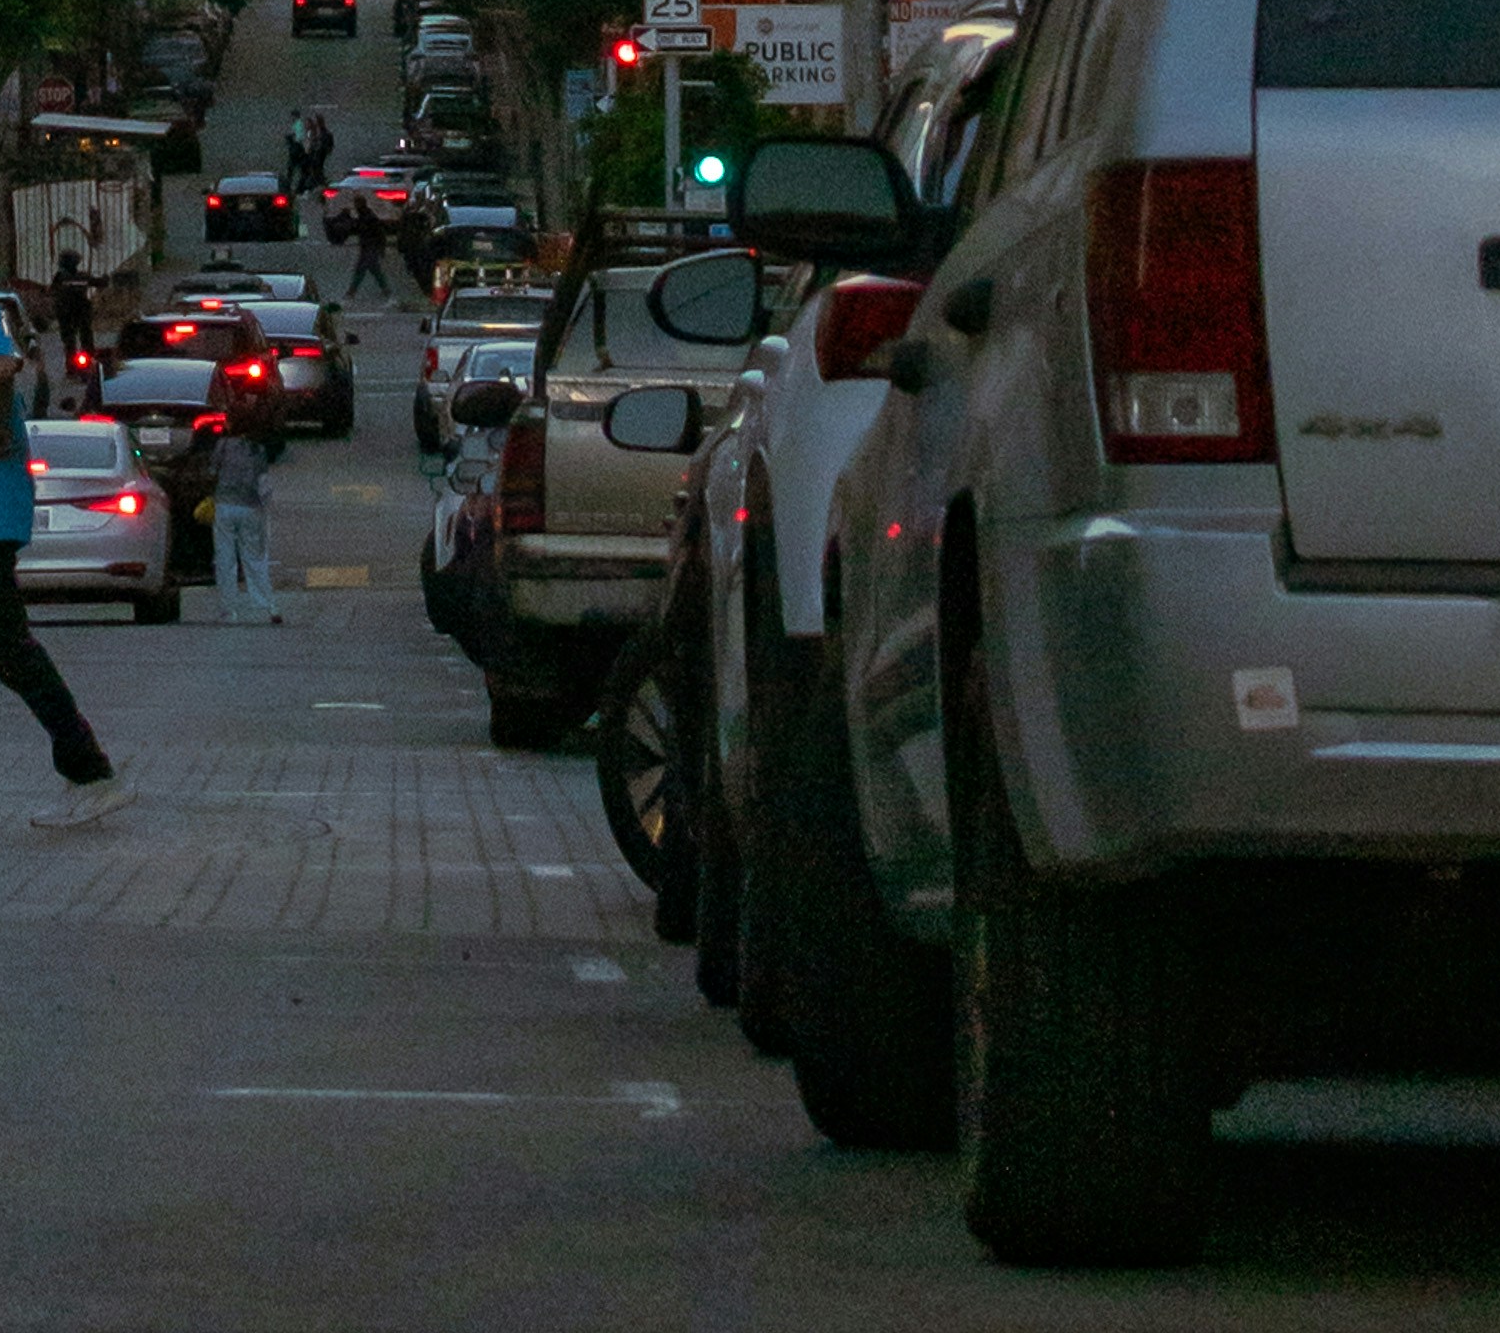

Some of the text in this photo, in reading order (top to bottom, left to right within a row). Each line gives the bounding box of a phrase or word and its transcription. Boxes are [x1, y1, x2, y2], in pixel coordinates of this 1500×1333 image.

[746, 42, 835, 62] PUBLIC
[760, 67, 836, 83] ARKING
[38, 86, 72, 102] STOP
